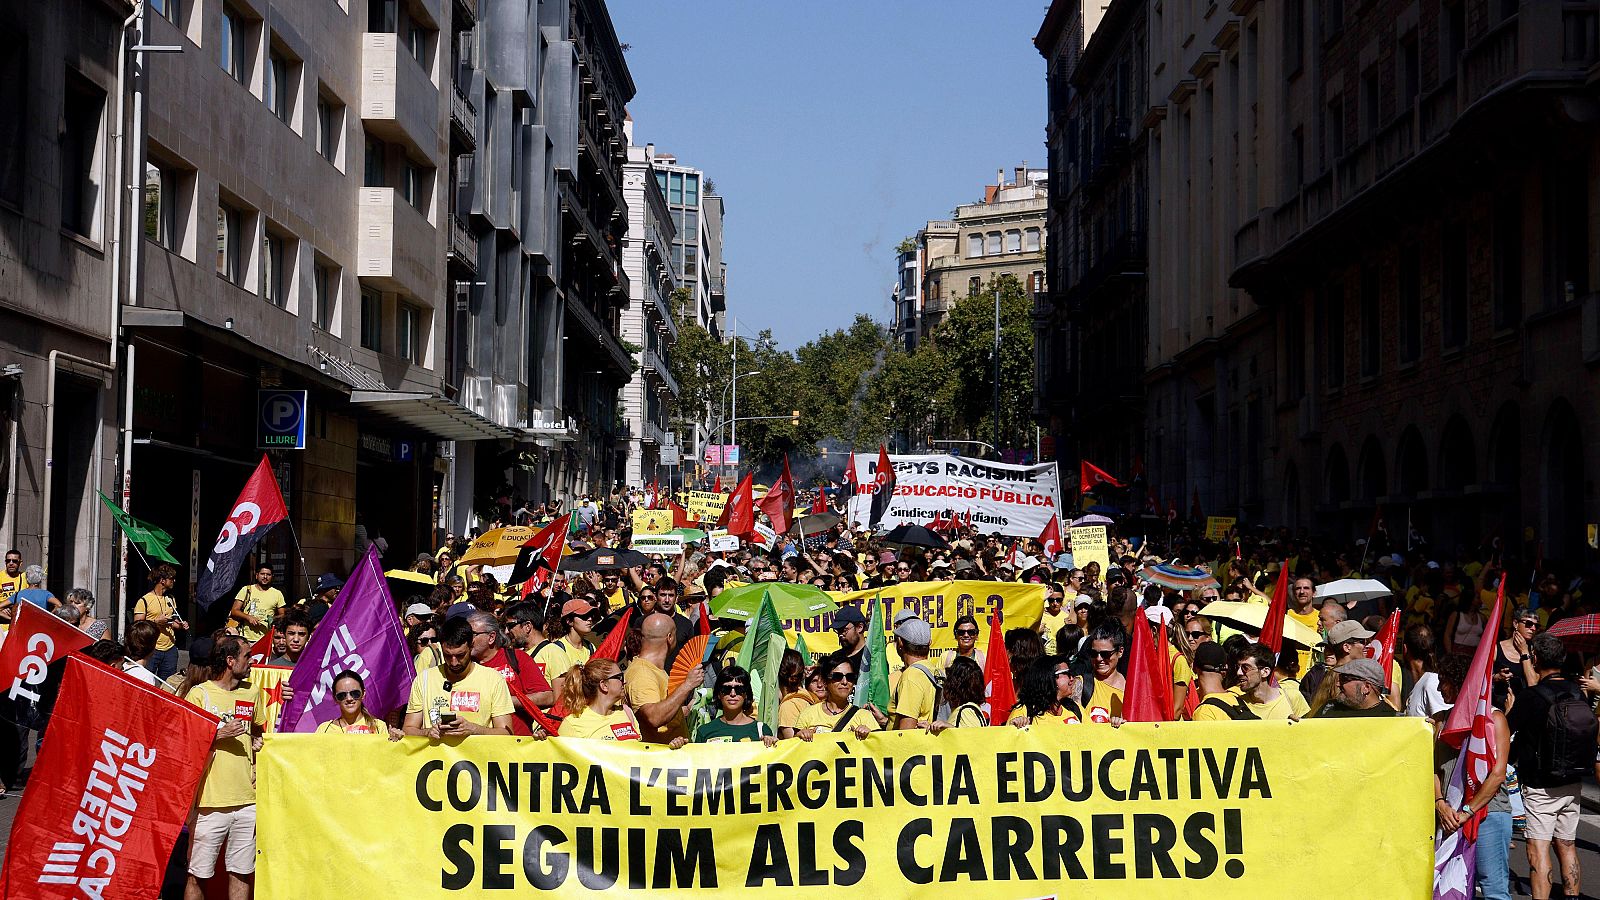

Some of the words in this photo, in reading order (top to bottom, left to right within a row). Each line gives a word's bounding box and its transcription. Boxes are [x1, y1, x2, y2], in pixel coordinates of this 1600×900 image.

[272, 400, 294, 426] P
[533, 420, 566, 429] Hotel
[265, 435, 296, 444] LLIURE
[400, 441, 409, 460] P
[945, 462, 1038, 483] RACISME
[892, 484, 978, 499] EDUCACIÓ
[980, 485, 1055, 508] PÚBLICA
[890, 506, 940, 519] Sindicat
[416, 760, 611, 816] CONTRA
[630, 742, 980, 817] L'EMERGÈNCIA
[997, 747, 1272, 804] EDUCATIVA
[442, 822, 719, 890] SEGUIM
[745, 820, 866, 888] ALS
[897, 809, 1244, 885] CARRERS!
